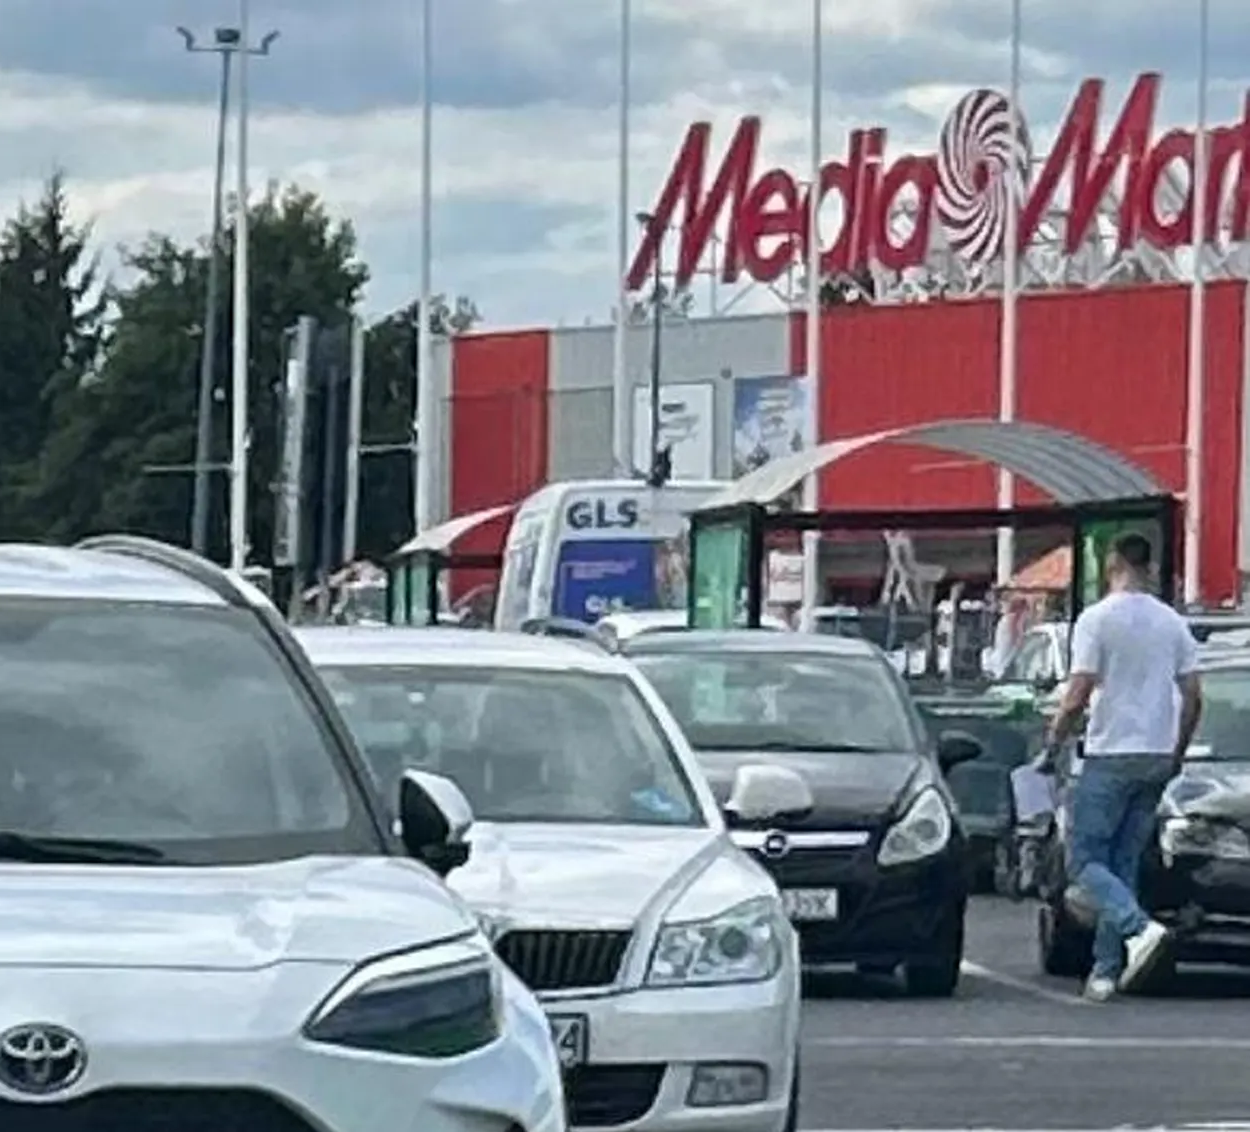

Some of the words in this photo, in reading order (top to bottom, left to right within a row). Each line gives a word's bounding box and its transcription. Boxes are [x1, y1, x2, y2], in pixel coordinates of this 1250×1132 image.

[624, 114, 940, 291] Media
[1014, 72, 1250, 256] Mar
[566, 498, 638, 529] GLS
